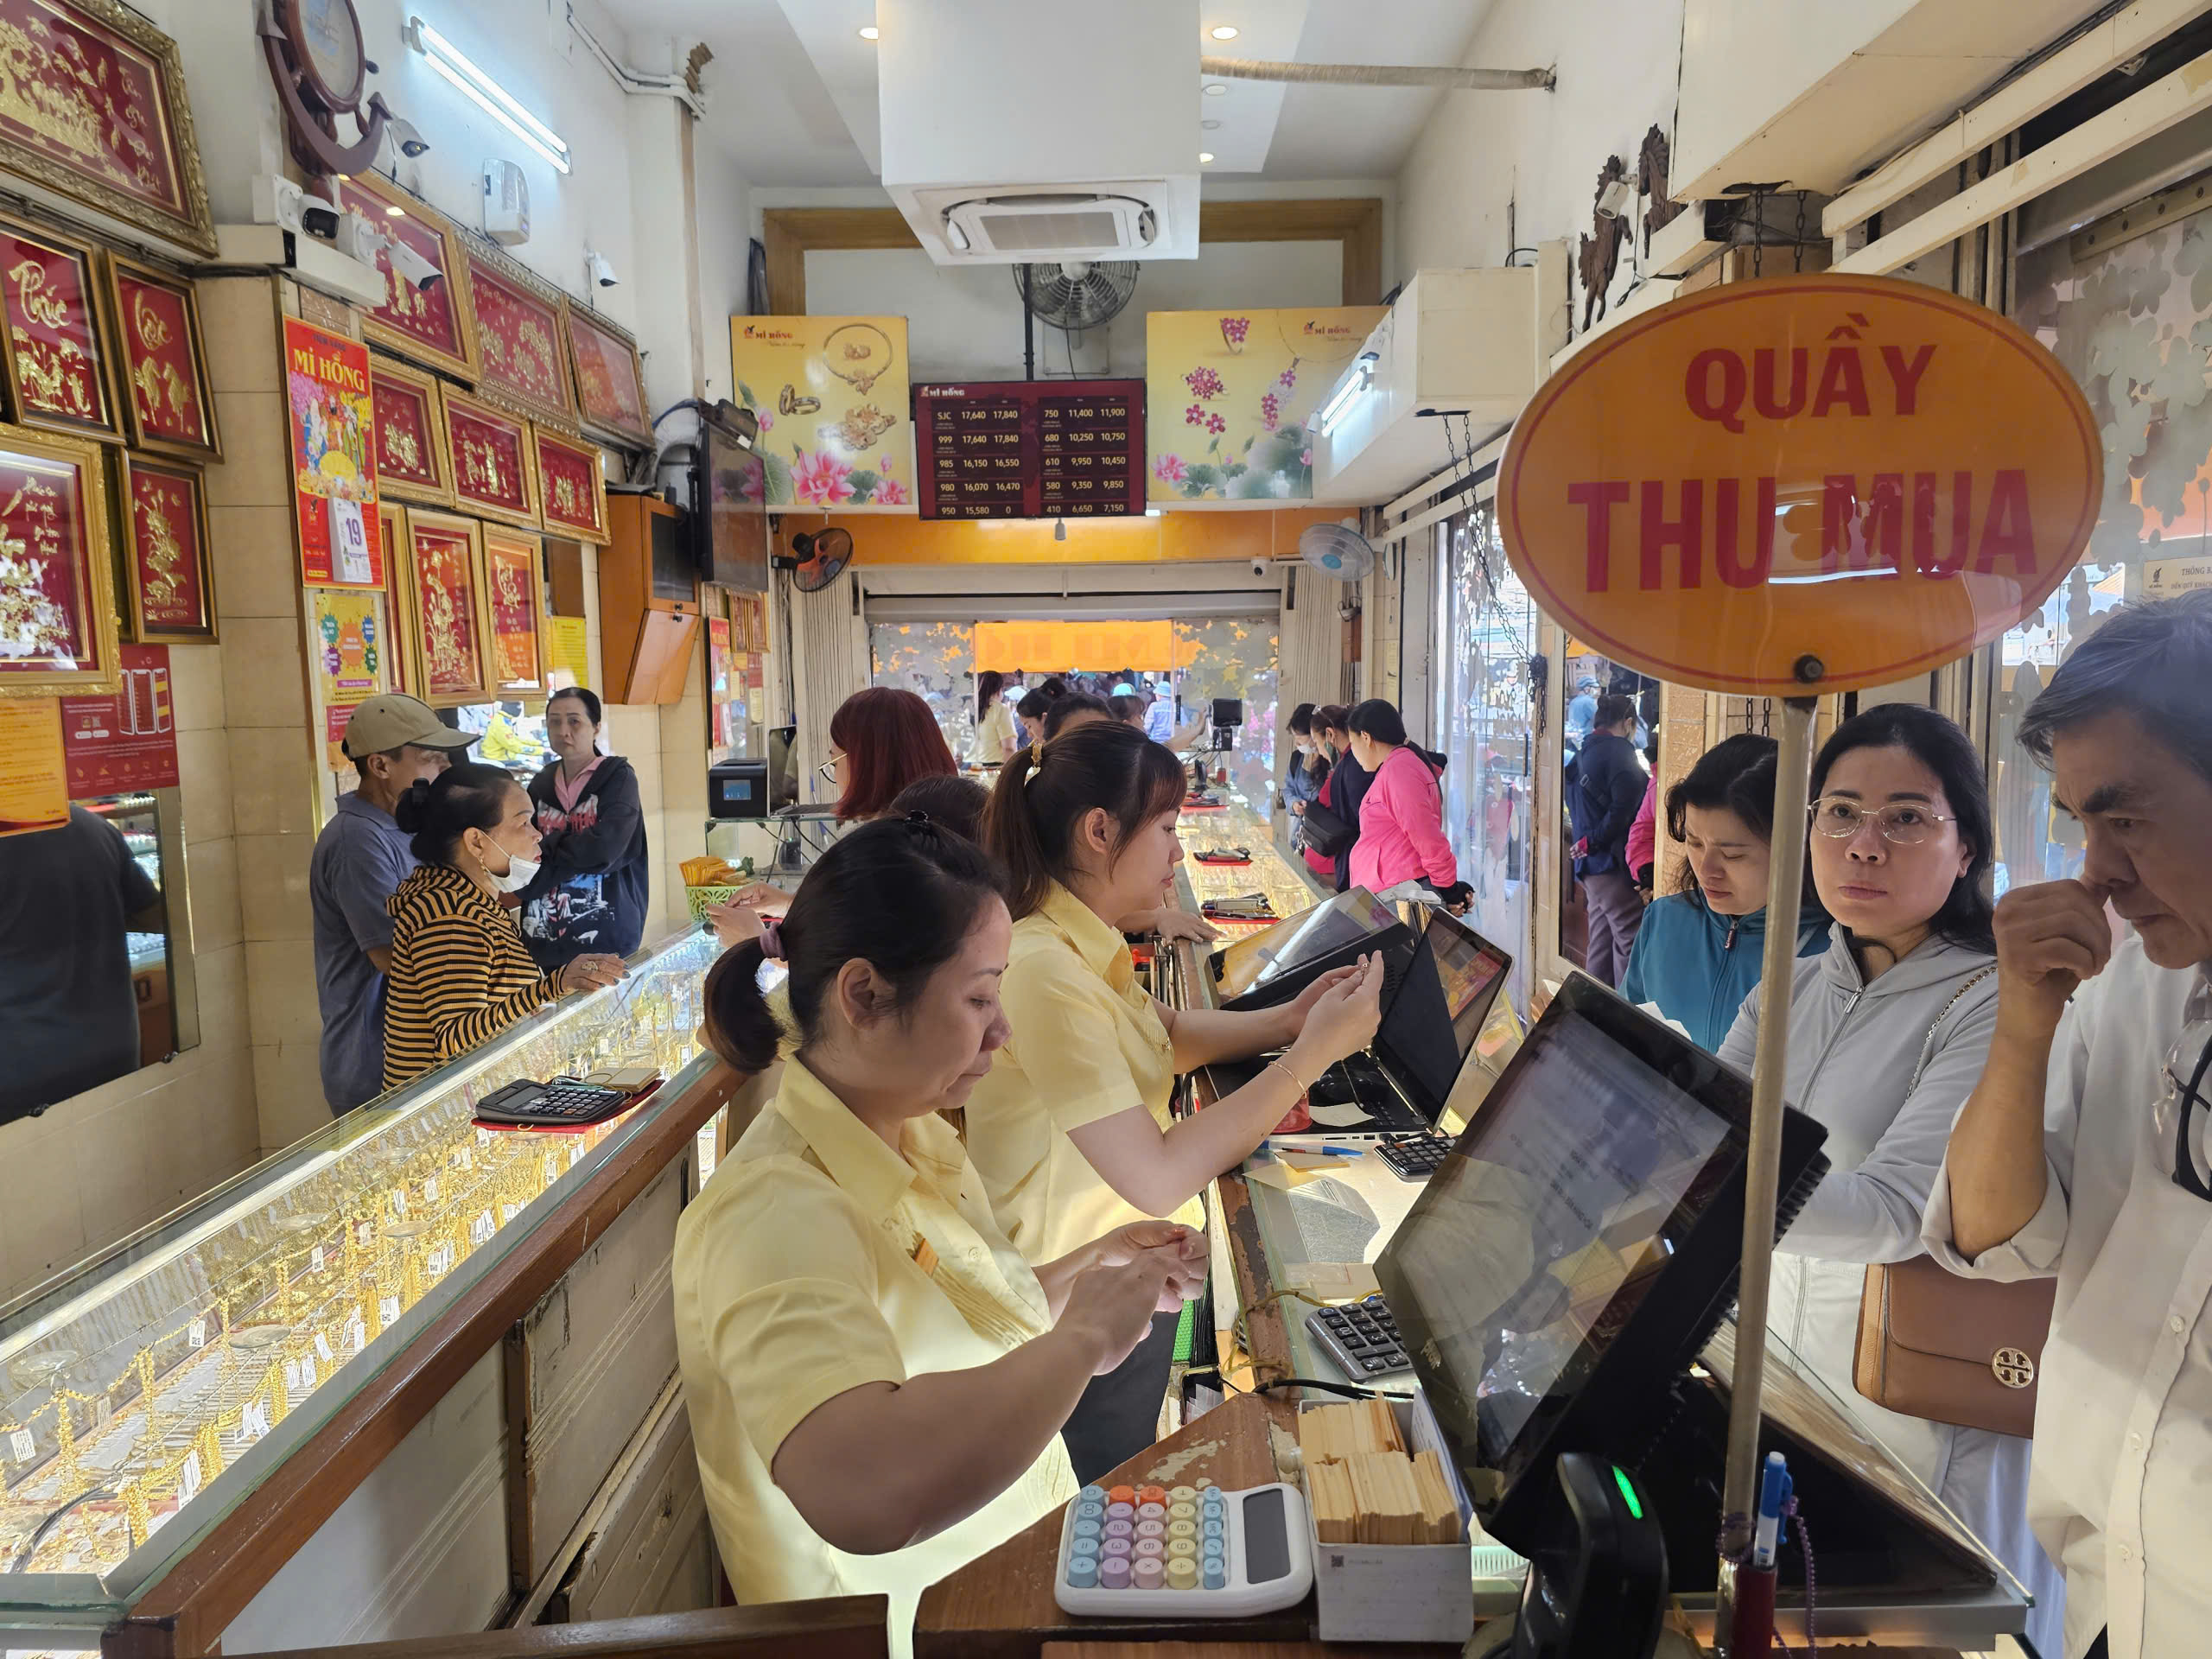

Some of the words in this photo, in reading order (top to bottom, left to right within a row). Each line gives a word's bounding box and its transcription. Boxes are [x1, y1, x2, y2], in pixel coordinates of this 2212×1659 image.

[319, 350, 365, 392] HỒNG
[1684, 313, 1936, 434] QUẦY
[937, 411, 951, 420] SJC
[961, 410, 987, 421] 17,640
[993, 410, 1018, 420] 17,840
[1044, 410, 1059, 418] 750
[1068, 409, 1094, 418] 11,400
[1100, 408, 1126, 417] 11,900
[962, 435, 987, 445] 17,640
[994, 435, 1019, 444] 17,840
[1045, 434, 1059, 442] 680
[1069, 433, 1094, 442] 10,250
[1101, 432, 1126, 442] 10,750
[963, 459, 988, 468] 16,150
[995, 458, 1020, 468] 16,550
[1045, 457, 1060, 466] 610
[1071, 457, 1092, 467] 9,950
[1101, 456, 1126, 466] 10,450
[940, 483, 955, 492] 980
[963, 483, 988, 493] 16,070
[995, 482, 1020, 492] 16,470
[1046, 481, 1061, 490] 580
[1071, 480, 1093, 491] 9,350
[1103, 480, 1124, 490] 9,850
[941, 506, 956, 515] 950
[965, 506, 989, 516] 15,580
[1005, 505, 1012, 514] 0
[1071, 505, 1093, 514] 6,650
[1103, 504, 1124, 513] 7,150
[346, 518, 362, 546] 19
[1567, 478, 1776, 593] THU
[1821, 468, 2037, 581] MUA
[2181, 565, 2205, 576] THÔNG
